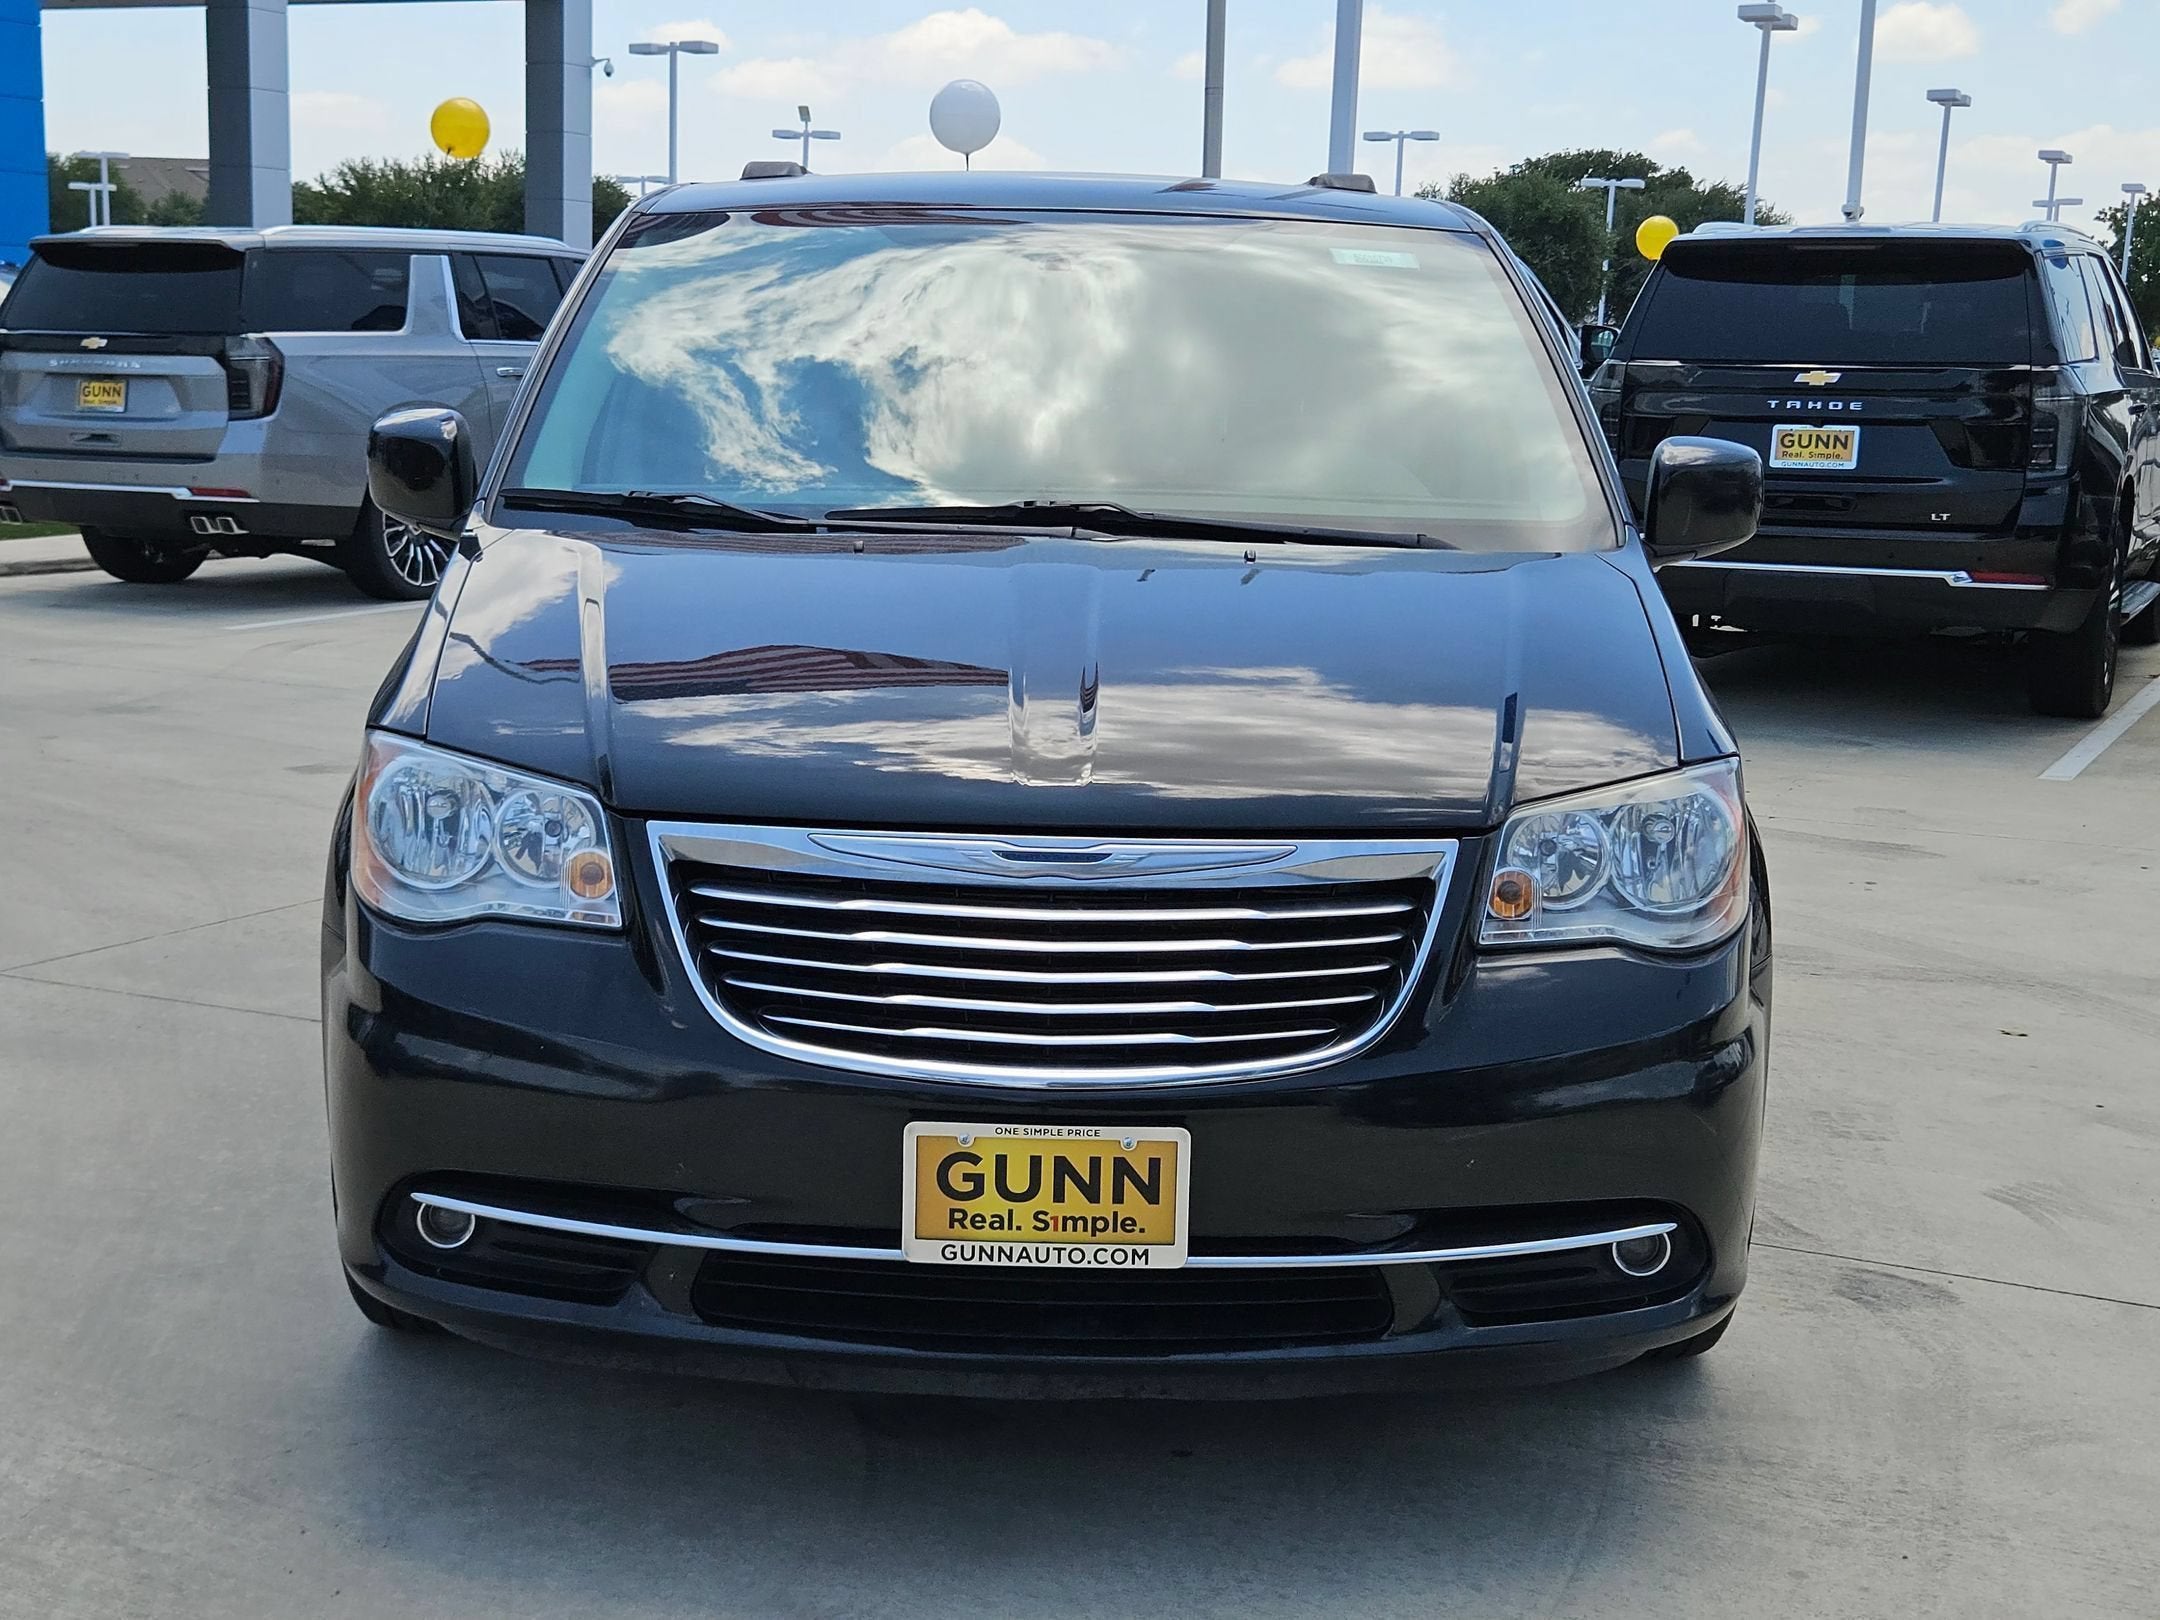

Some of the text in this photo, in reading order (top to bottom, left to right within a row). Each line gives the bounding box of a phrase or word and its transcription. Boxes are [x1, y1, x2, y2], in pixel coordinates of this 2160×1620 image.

[82, 385, 122, 397] GUNN
[1767, 400, 1863, 410] TAHOE
[1780, 432, 1849, 450] GUNN
[1931, 513, 1951, 521] LT
[994, 1126, 1101, 1138] ONE SIMPLE PRICE
[936, 1151, 1161, 1205] GUNN
[948, 1207, 1022, 1232] Real.
[941, 1244, 1149, 1266] GUNNAUTO.COM
